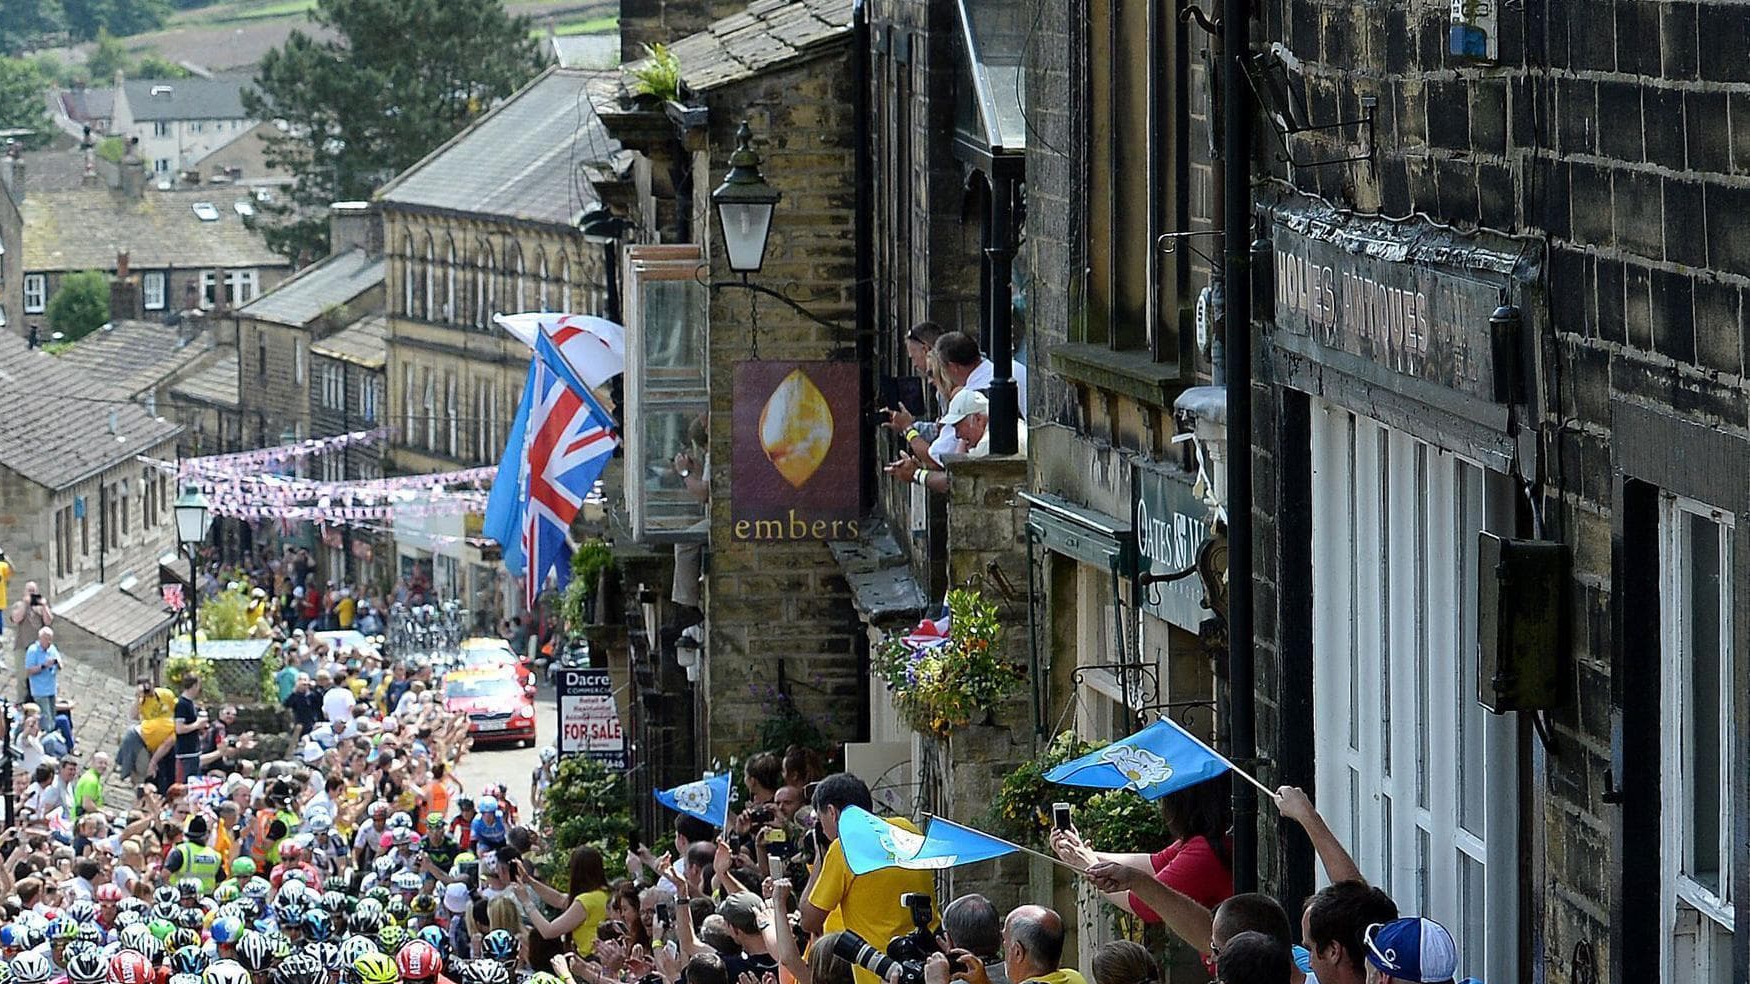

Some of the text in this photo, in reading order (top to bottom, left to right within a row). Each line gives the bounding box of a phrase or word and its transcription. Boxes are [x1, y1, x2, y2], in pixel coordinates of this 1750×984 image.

[735, 508, 858, 539] embers
[564, 723, 622, 740] FOR SALE
